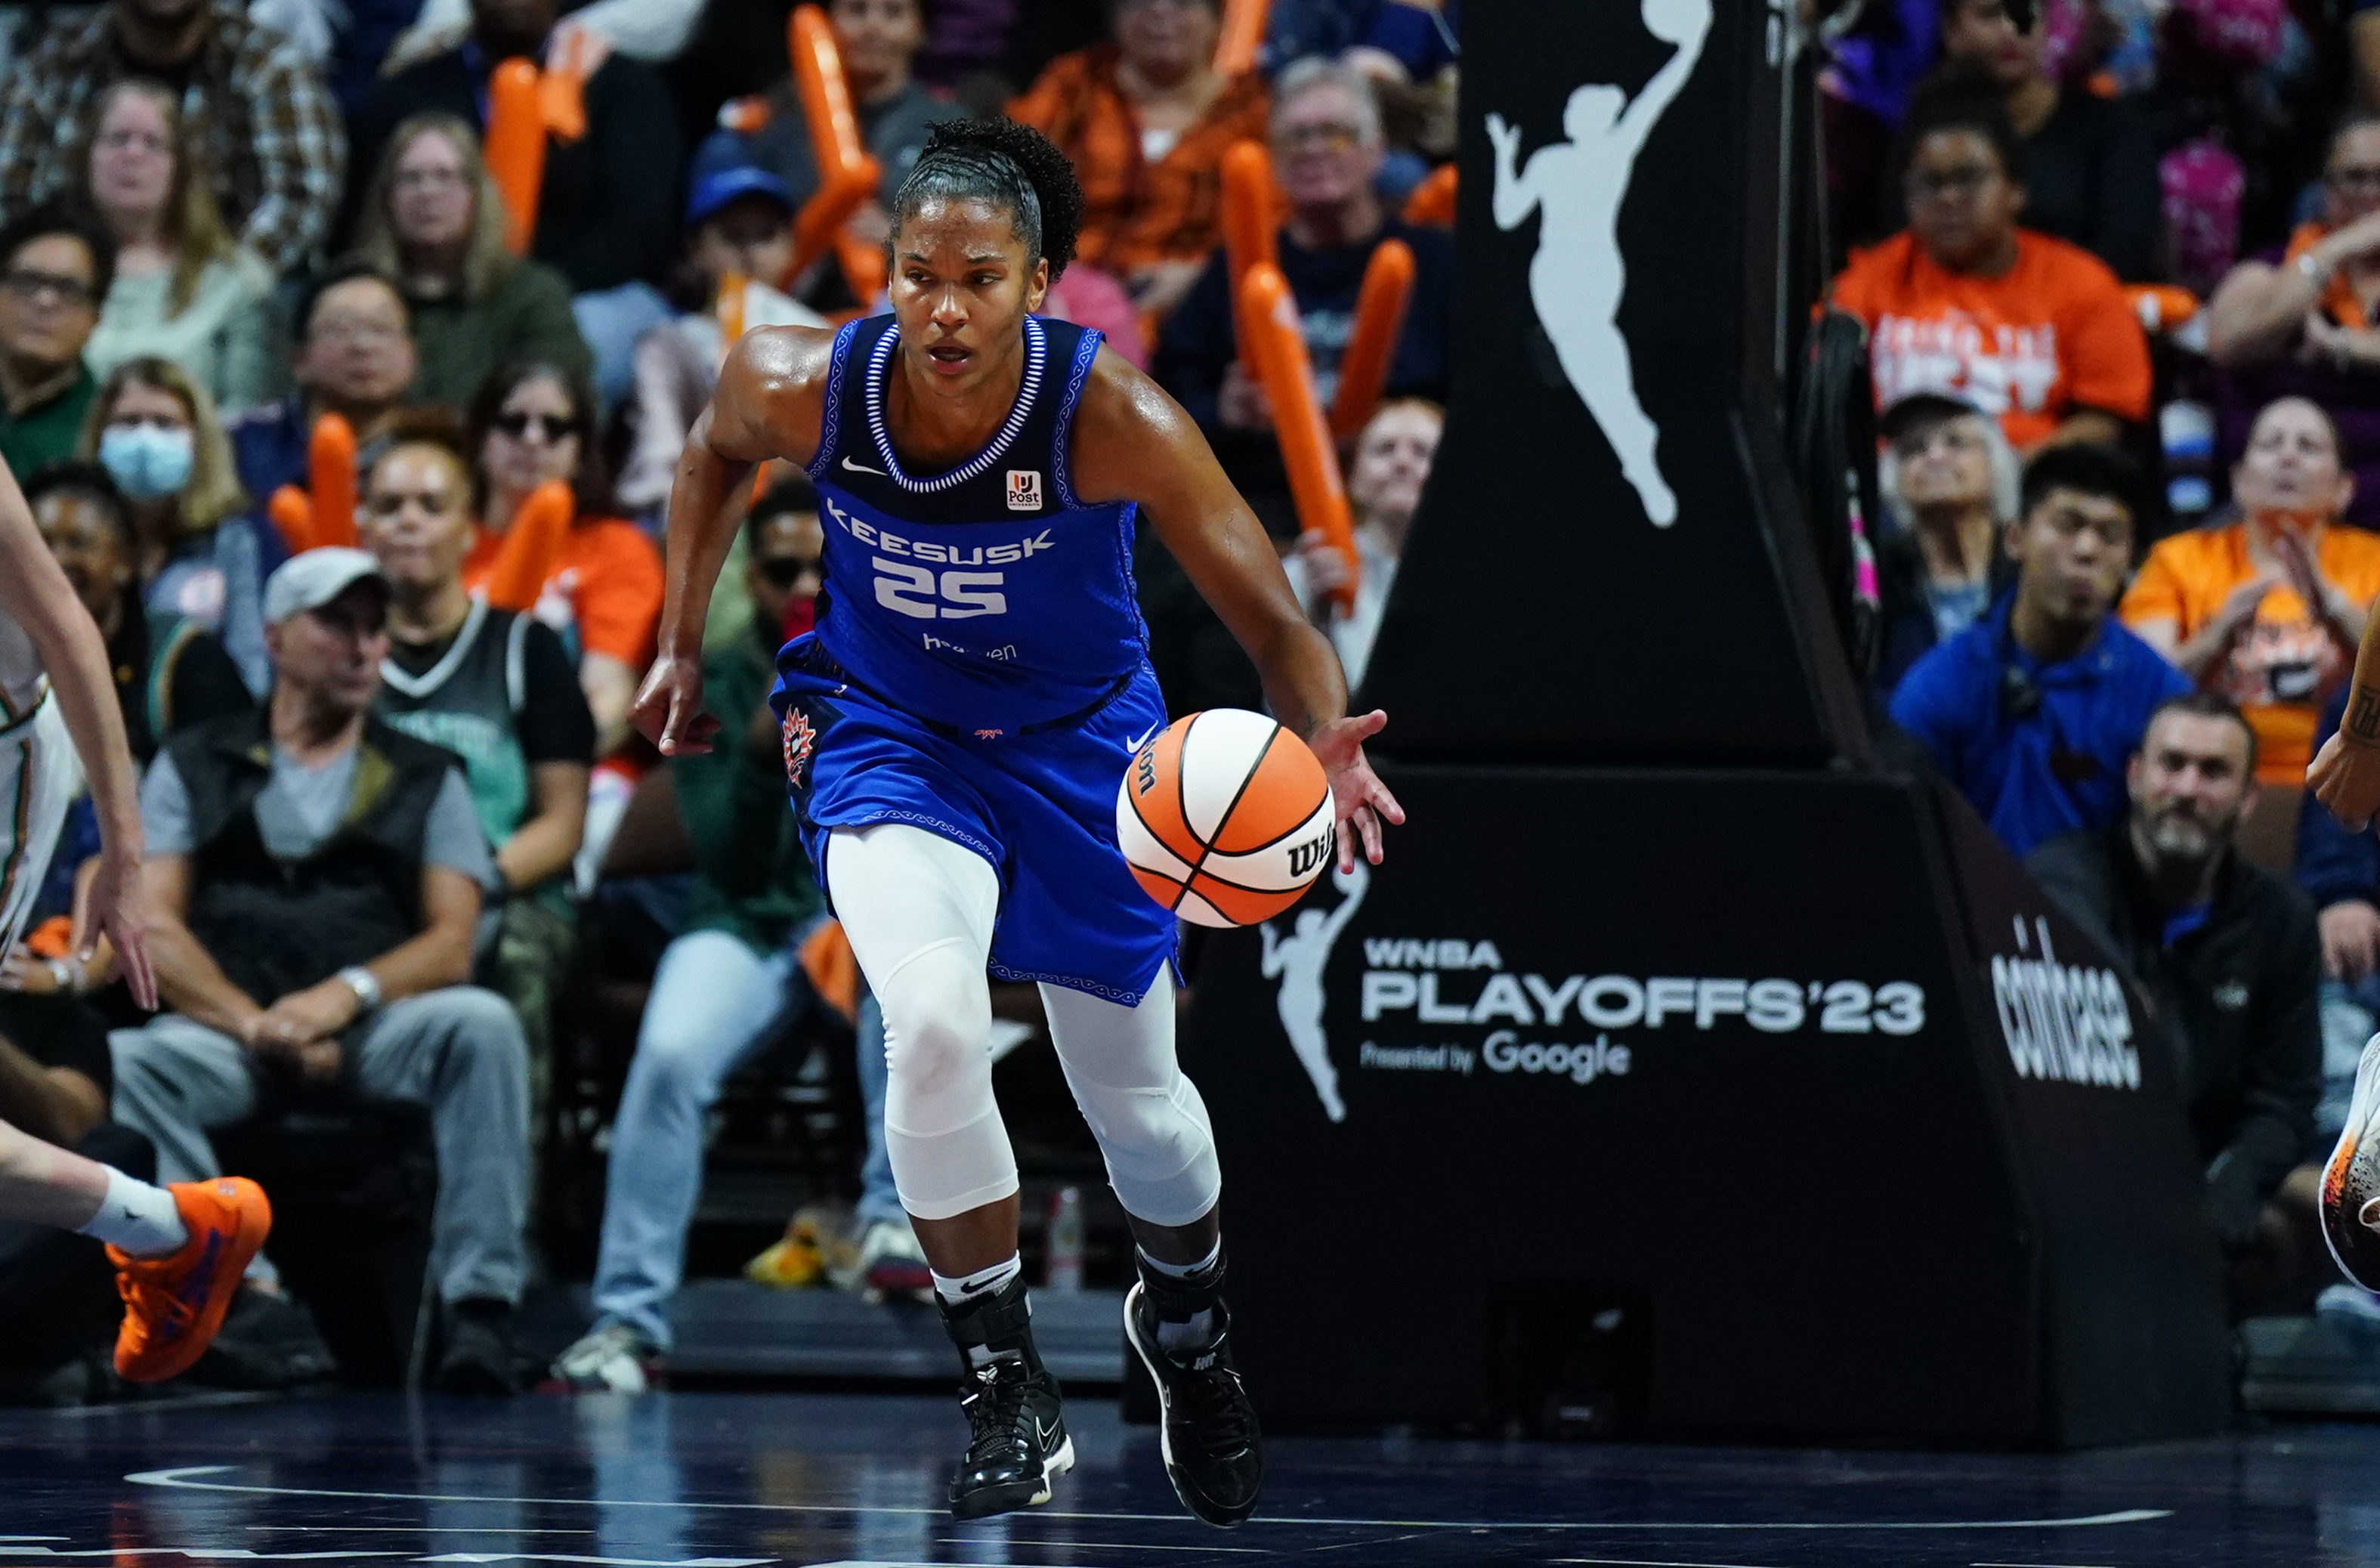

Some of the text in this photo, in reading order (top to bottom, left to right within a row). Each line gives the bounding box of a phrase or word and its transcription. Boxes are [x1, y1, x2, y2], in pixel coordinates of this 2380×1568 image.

[1009, 490, 1040, 503] Post
[827, 497, 1056, 565] KEESUSK
[872, 556, 1007, 619] 25
[1363, 938, 1503, 970] WNBA
[1482, 1029, 1631, 1085] Google
